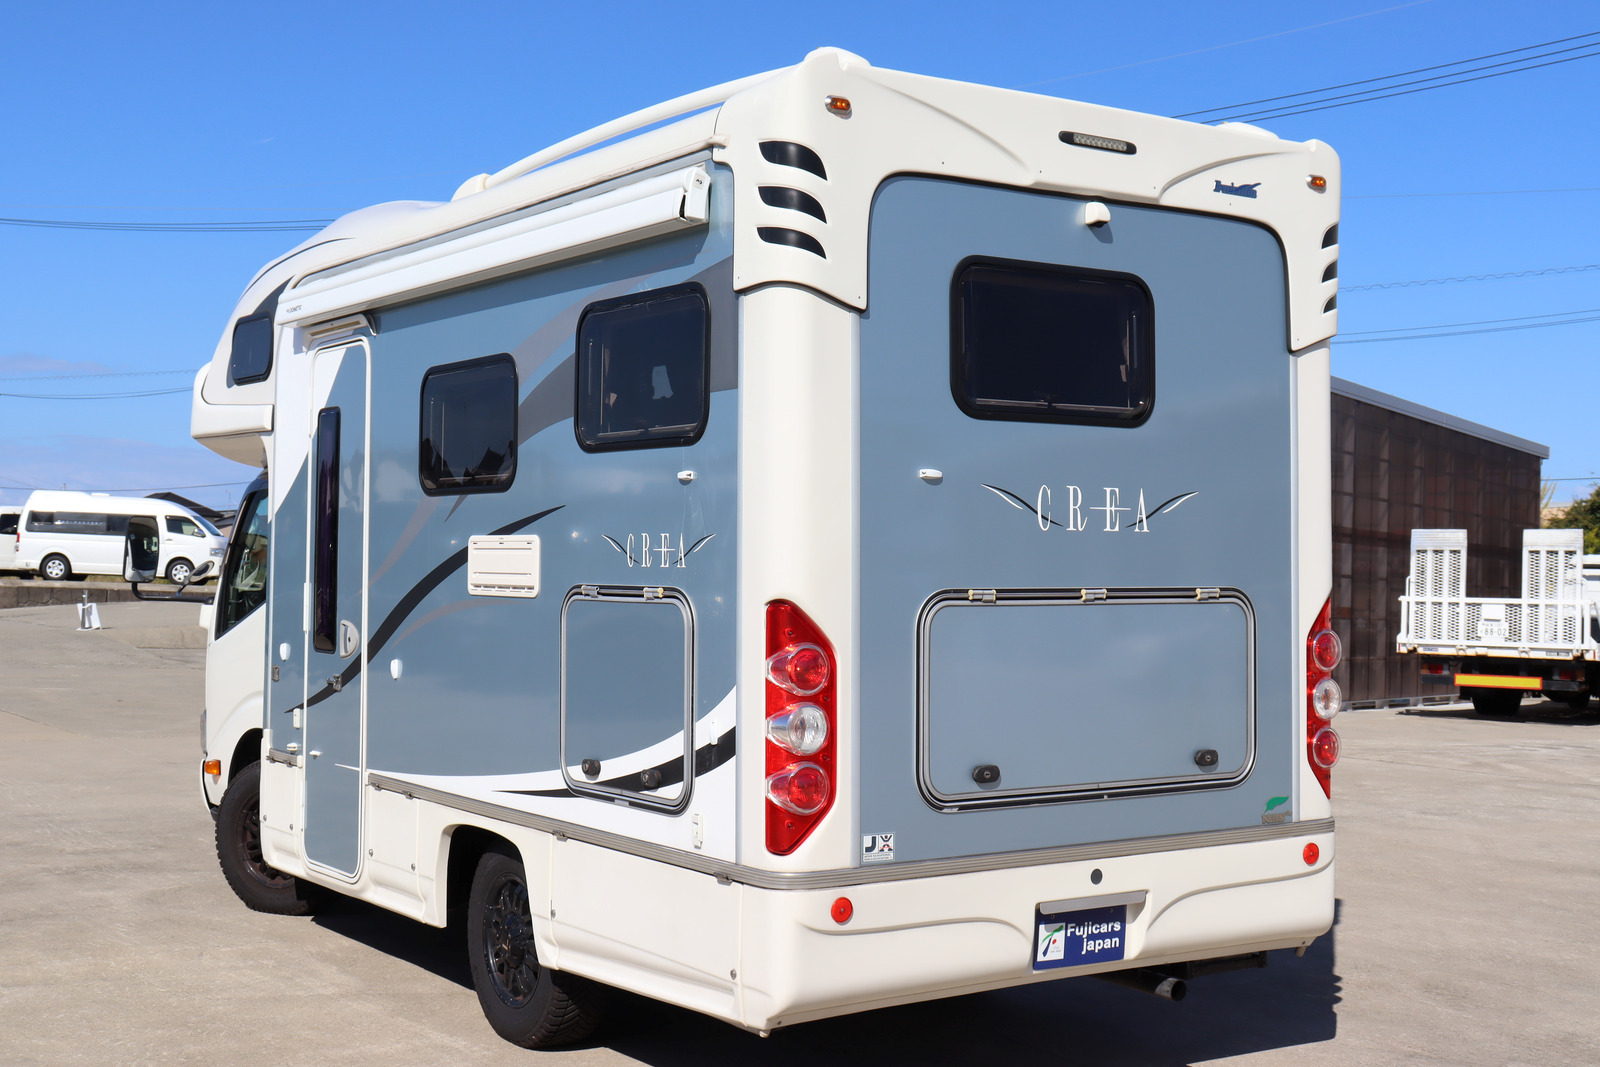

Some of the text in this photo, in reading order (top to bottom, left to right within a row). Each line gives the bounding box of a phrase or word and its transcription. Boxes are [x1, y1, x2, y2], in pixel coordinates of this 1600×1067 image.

[1037, 484, 1150, 532] CREA
[626, 532, 686, 568] CREA
[1066, 921, 1122, 938] Fujicars
[1081, 937, 1120, 955] japan
